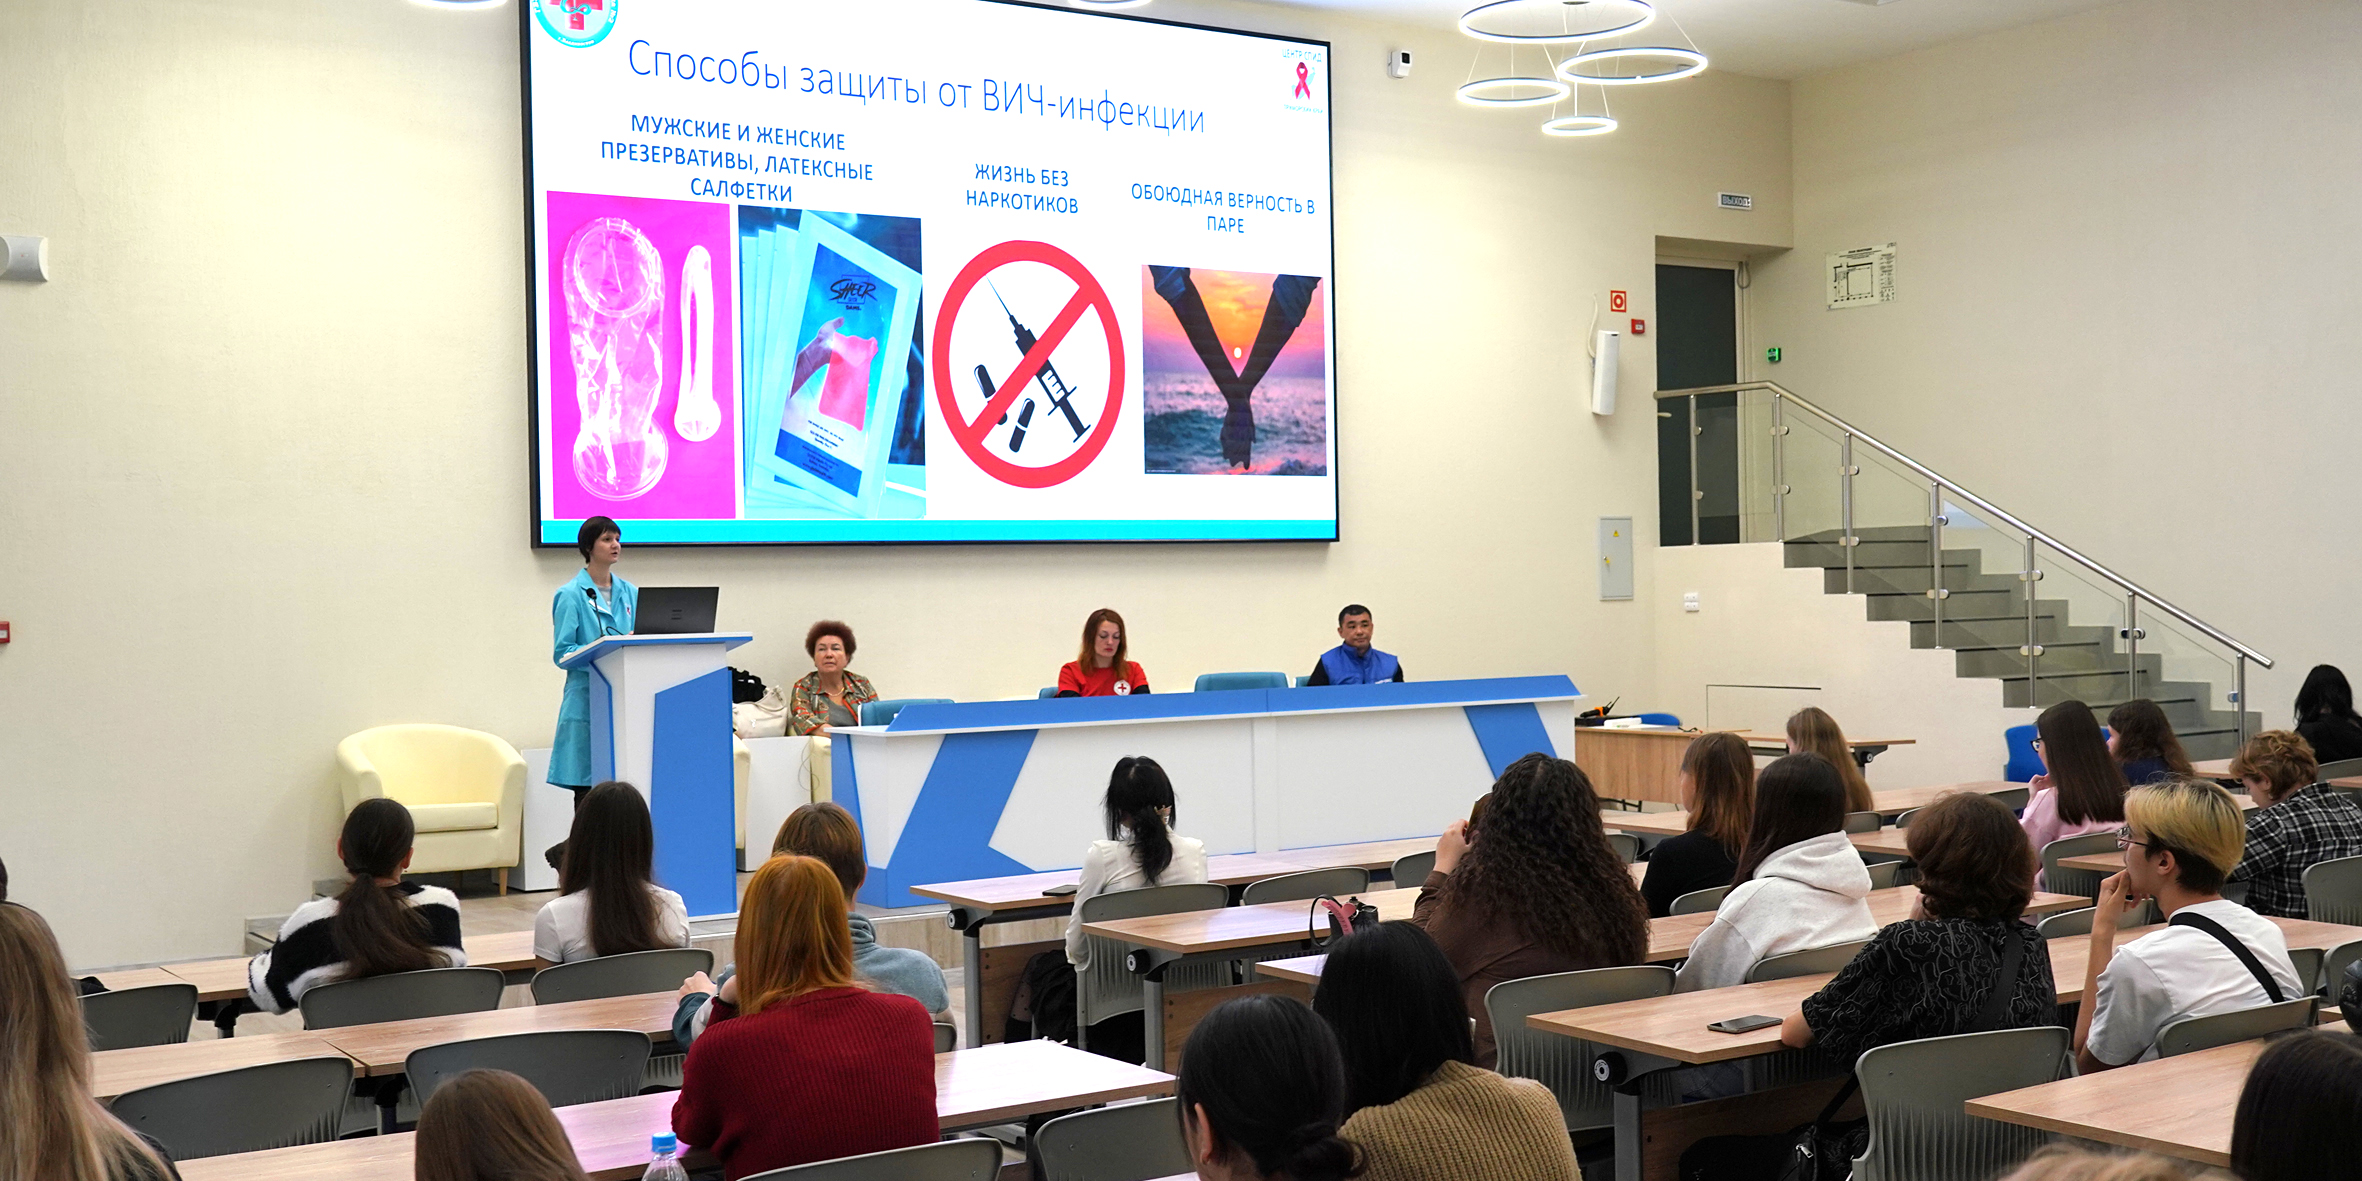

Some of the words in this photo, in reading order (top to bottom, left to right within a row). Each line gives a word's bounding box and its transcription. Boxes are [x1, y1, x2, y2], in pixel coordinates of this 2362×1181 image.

[629, 39, 786, 90] Способы
[801, 68, 926, 106] защиты
[939, 82, 973, 108] от
[984, 79, 1204, 137] ВИЧ-инфекции
[631, 115, 731, 140] МУЖСКИЕ
[738, 124, 750, 142] И
[757, 126, 846, 151] ЖЕНСКИЕ
[601, 142, 760, 175] ПРЕЗЕРВАТИВЫ,
[765, 156, 874, 181] ЛАТЕКСНЫЕ
[975, 163, 1037, 185] ЖИЗНЬ
[1041, 169, 1069, 188] БЕЗ
[690, 177, 793, 202] САЛФЕТКИ
[966, 190, 1079, 214] НАРКОТИКОВ
[1131, 183, 1223, 207] ОБОЮДНАЯ
[1228, 192, 1303, 214] ВЕРНОСТЬ
[1307, 199, 1316, 215] В
[1207, 216, 1245, 234] ПАРЕ
